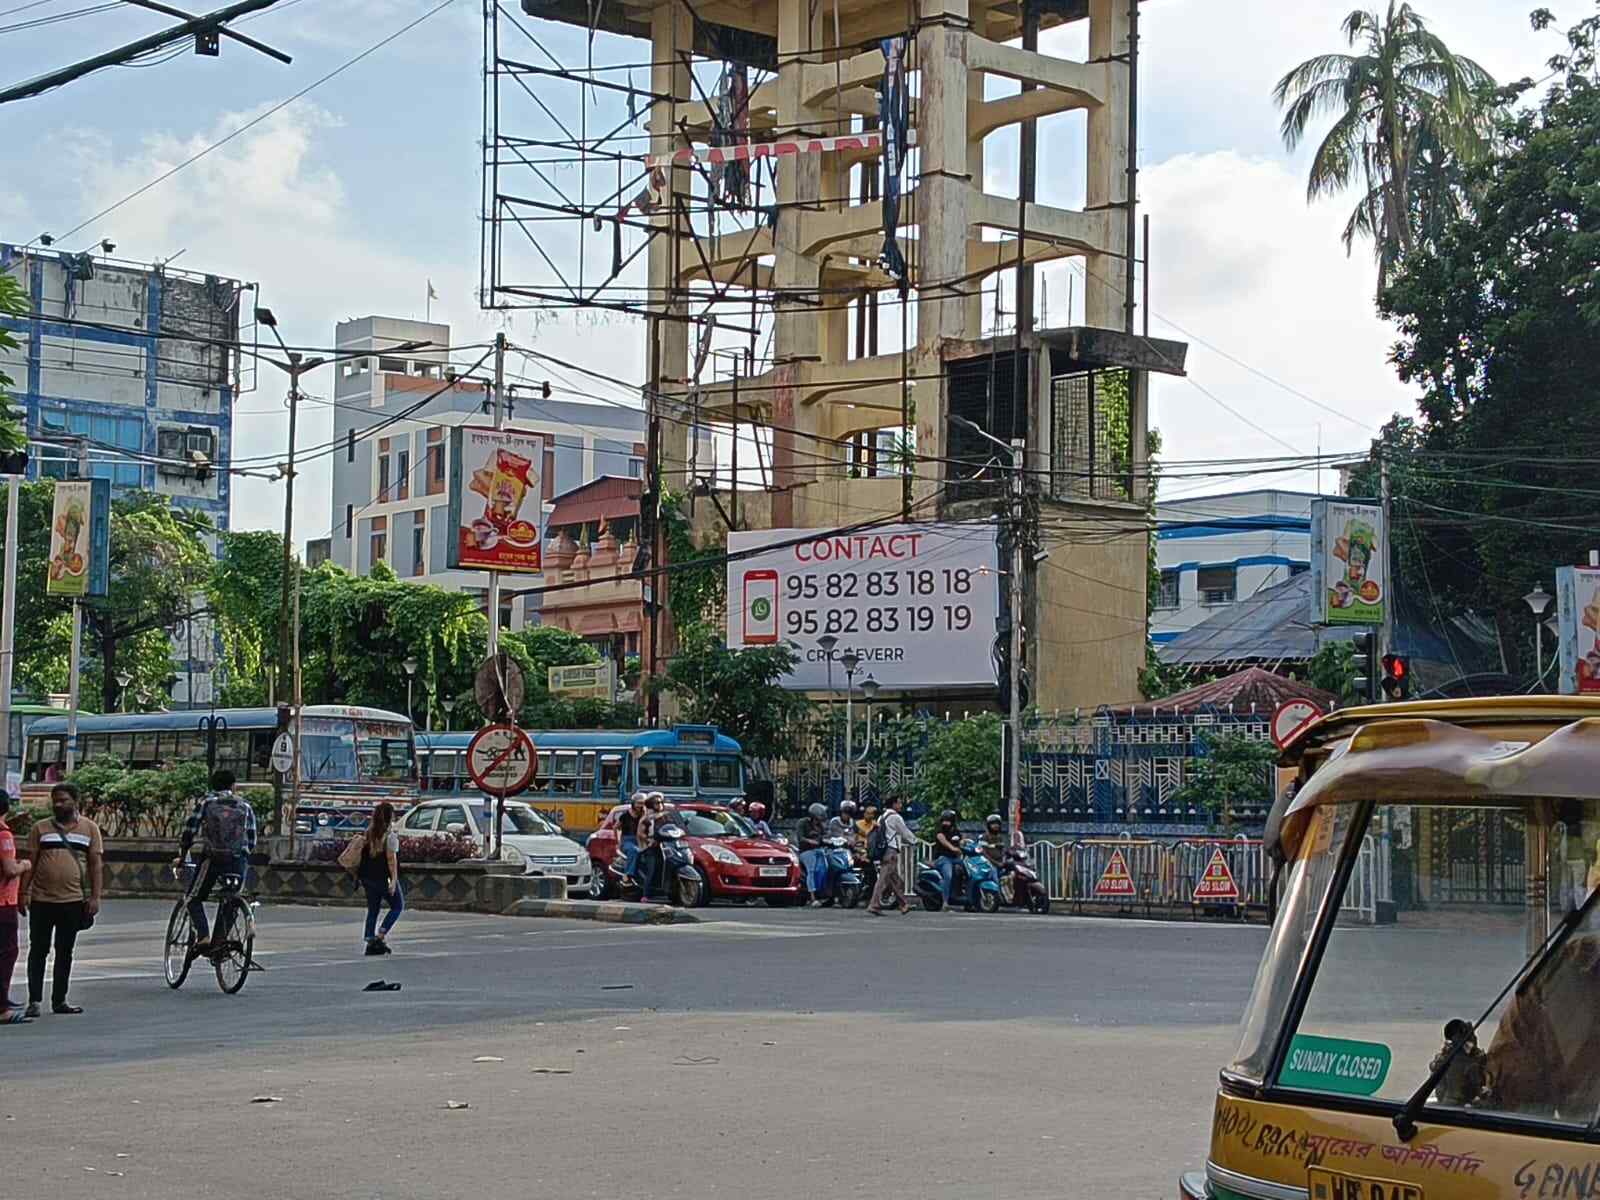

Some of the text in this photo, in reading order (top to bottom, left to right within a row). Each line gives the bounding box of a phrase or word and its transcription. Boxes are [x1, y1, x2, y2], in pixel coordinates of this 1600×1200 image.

[795, 534, 922, 561] CONTACT
[786, 568, 971, 600] 95 82 83 18 18
[786, 605, 971, 635] 95 82 83 19 19
[1200, 880, 1231, 891] GO SLOW
[1289, 1047, 1382, 1081] SUNDAY CLOSED
